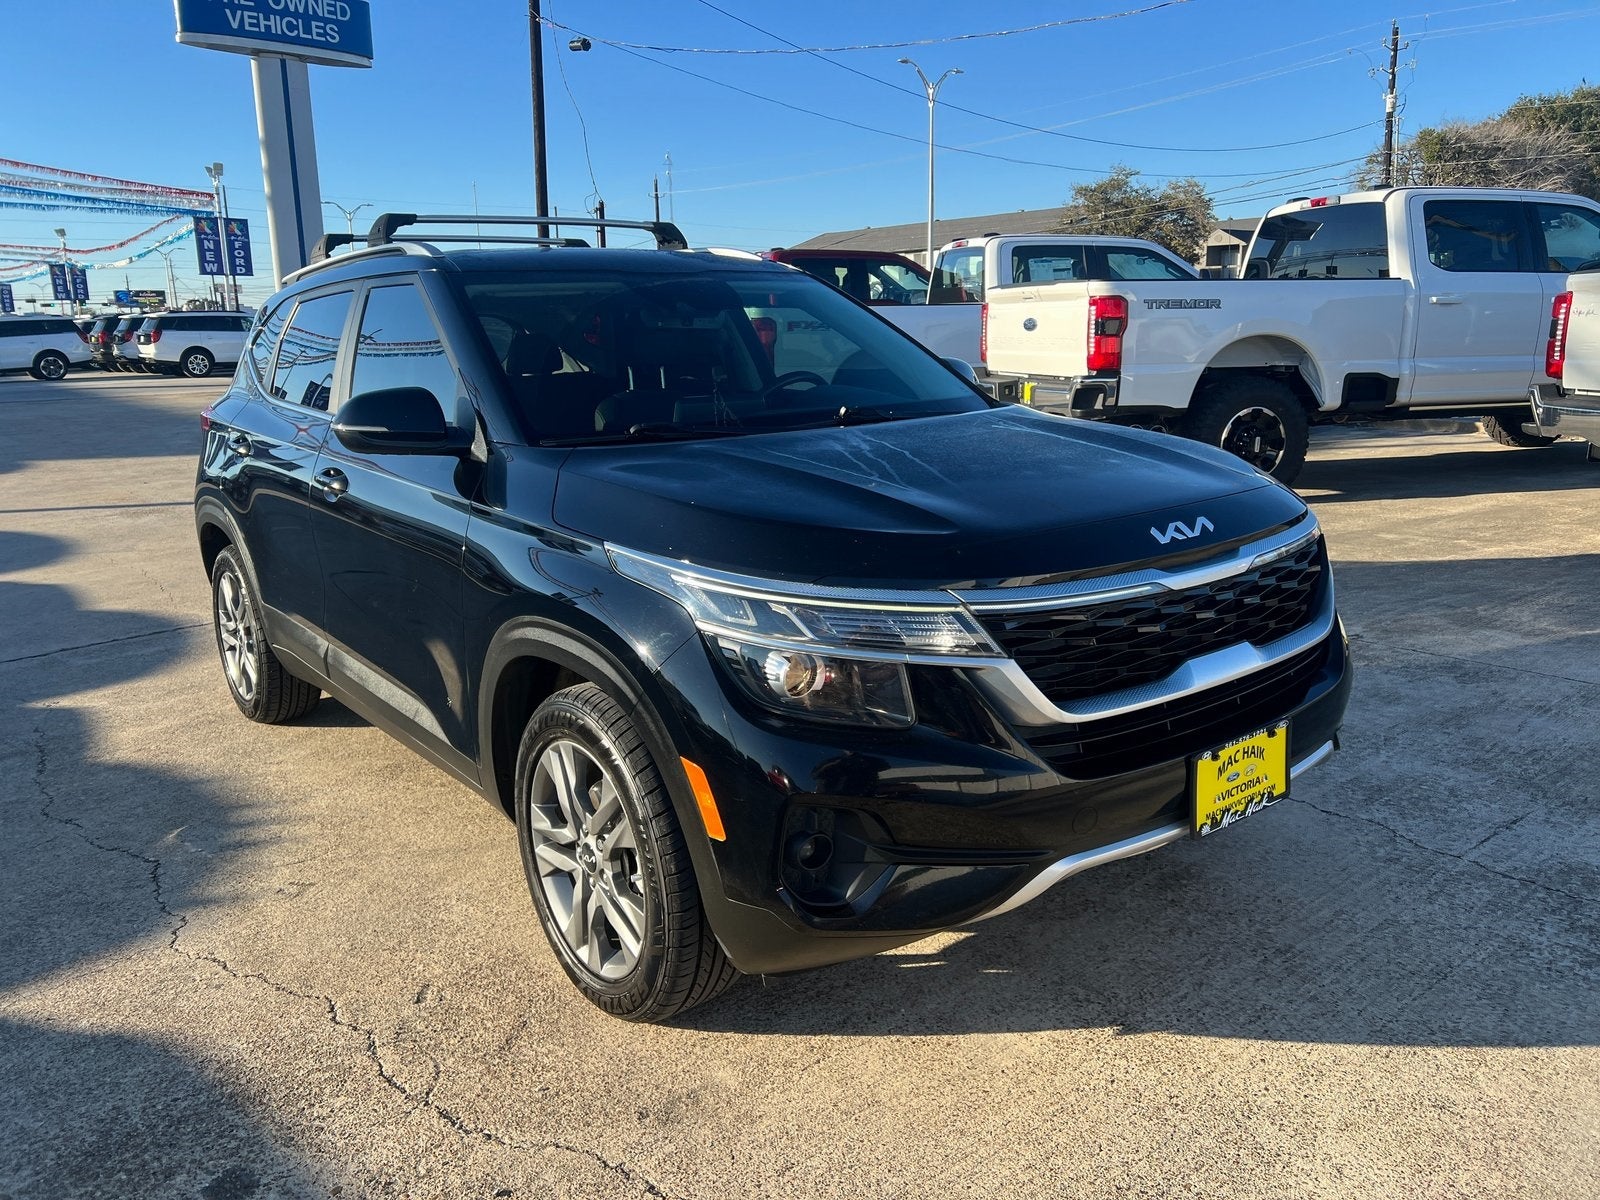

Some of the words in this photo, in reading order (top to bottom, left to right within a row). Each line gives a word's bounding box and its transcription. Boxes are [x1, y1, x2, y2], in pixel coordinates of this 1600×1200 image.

[226, 9, 340, 43] VEHICLES
[203, 239, 218, 273] NEW
[234, 241, 246, 274] FORD
[1143, 299, 1222, 310] TREMOR
[1150, 516, 1215, 544] KIA
[1217, 749, 1240, 780] MAC
[1242, 745, 1265, 761] HAIK
[1220, 776, 1261, 801] VICTORIA
[1219, 810, 1245, 828] Mac
